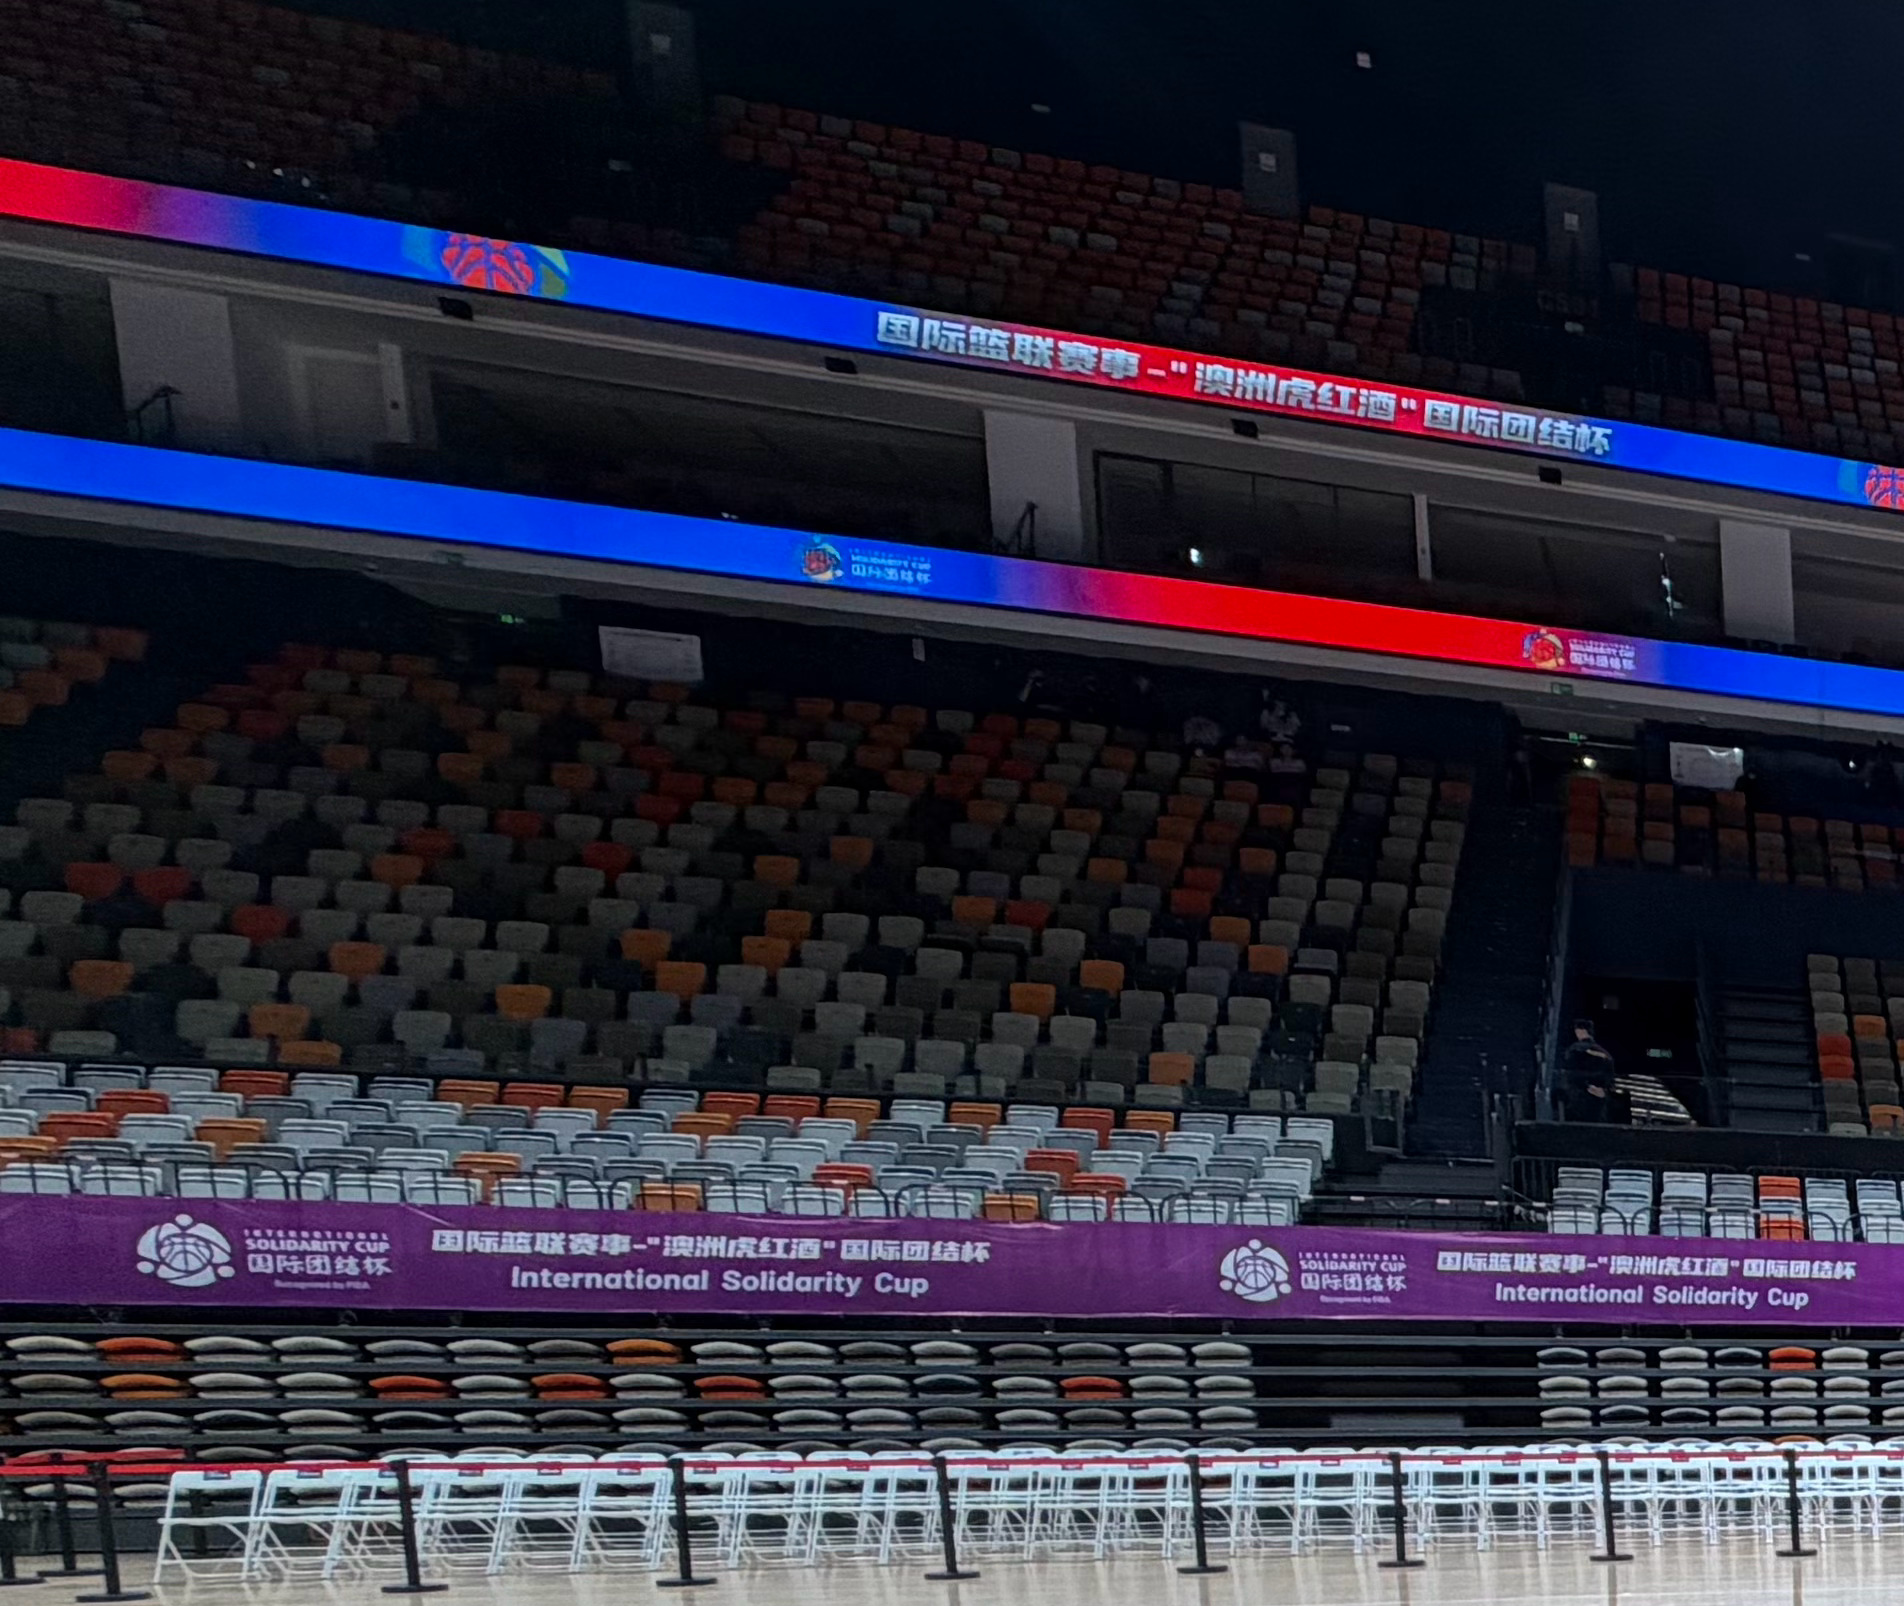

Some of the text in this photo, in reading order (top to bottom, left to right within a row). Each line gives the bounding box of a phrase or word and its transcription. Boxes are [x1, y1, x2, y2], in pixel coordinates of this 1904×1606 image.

[245, 1238, 391, 1254] SOLIDARITY CUP
[247, 1253, 393, 1276] 国际团结杯
[1299, 1260, 1407, 1273] SOLIDARITY CUP
[511, 1265, 930, 1298] International Solidarity Cup
[1495, 1282, 1809, 1310] International Solidarity Cup
